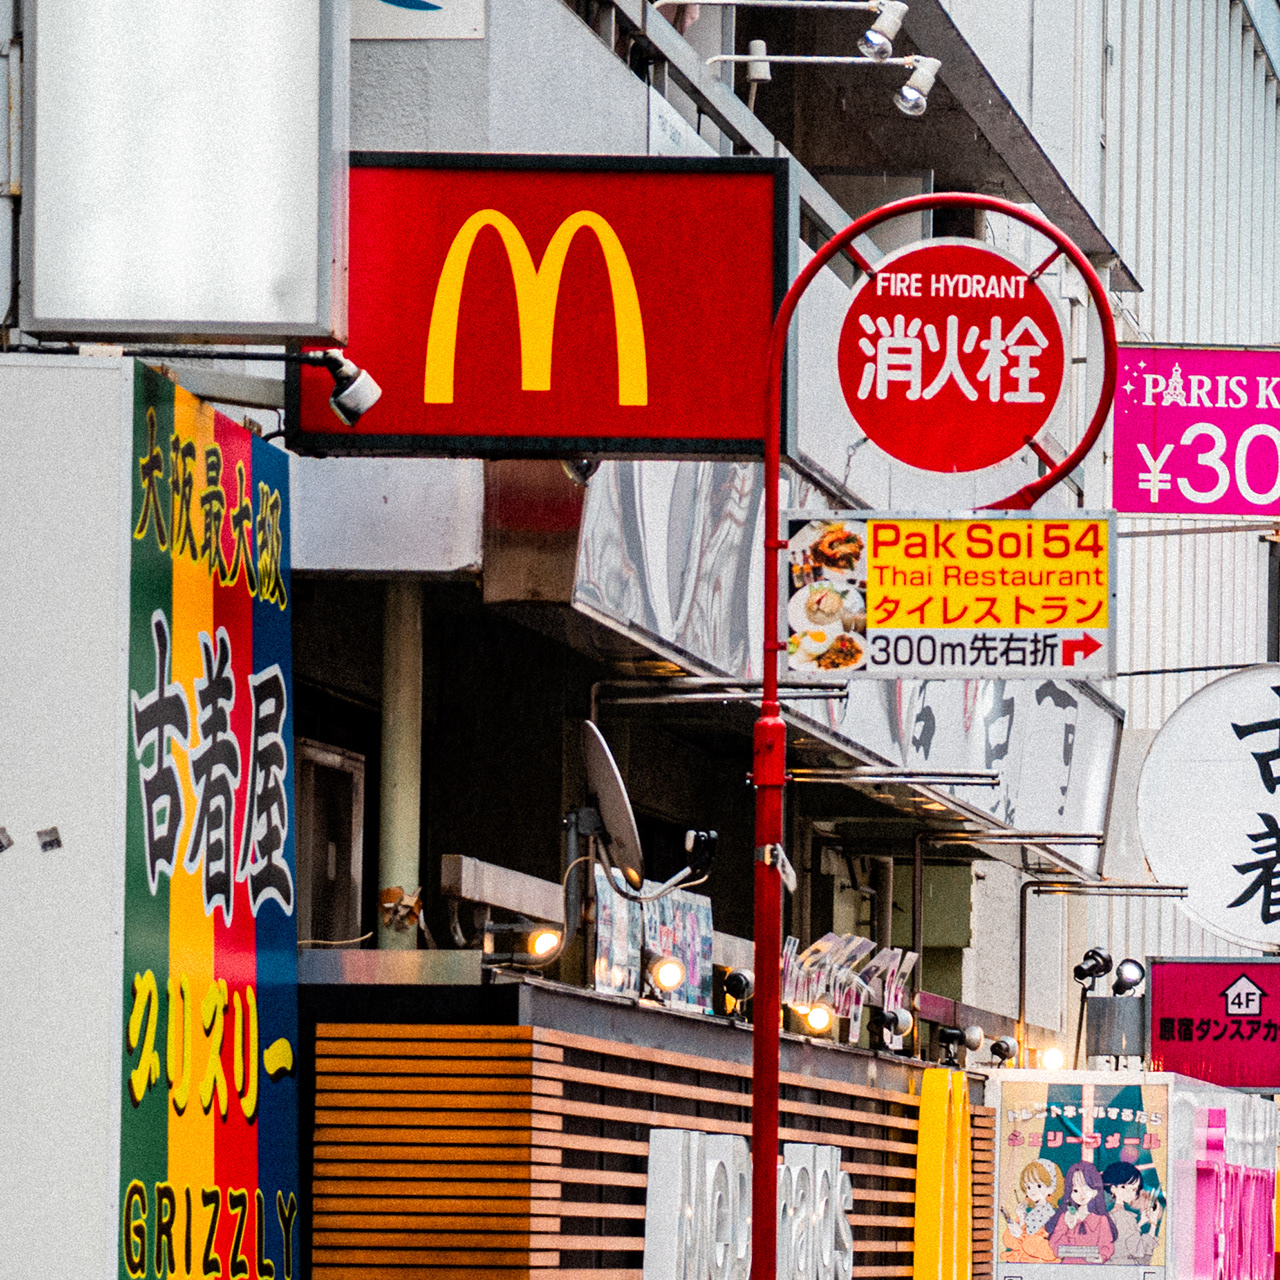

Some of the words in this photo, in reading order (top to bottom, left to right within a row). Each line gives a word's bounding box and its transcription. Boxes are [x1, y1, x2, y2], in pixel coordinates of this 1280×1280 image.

[877, 272, 922, 298] FIRE
[931, 273, 1028, 300] HYDRANT
[857, 314, 1048, 404] 消火栓
[133, 406, 288, 611] 大阪最大級
[872, 522, 957, 560] Pak
[965, 522, 1036, 560] Soi
[1042, 523, 1103, 560] 54
[873, 565, 935, 588] Thai
[942, 565, 1104, 588] Restaurant
[872, 595, 1104, 626] タイレストラン
[870, 633, 1059, 668] 300m先右折
[129, 609, 293, 927] 古着屋
[1231, 991, 1257, 1010] 4F
